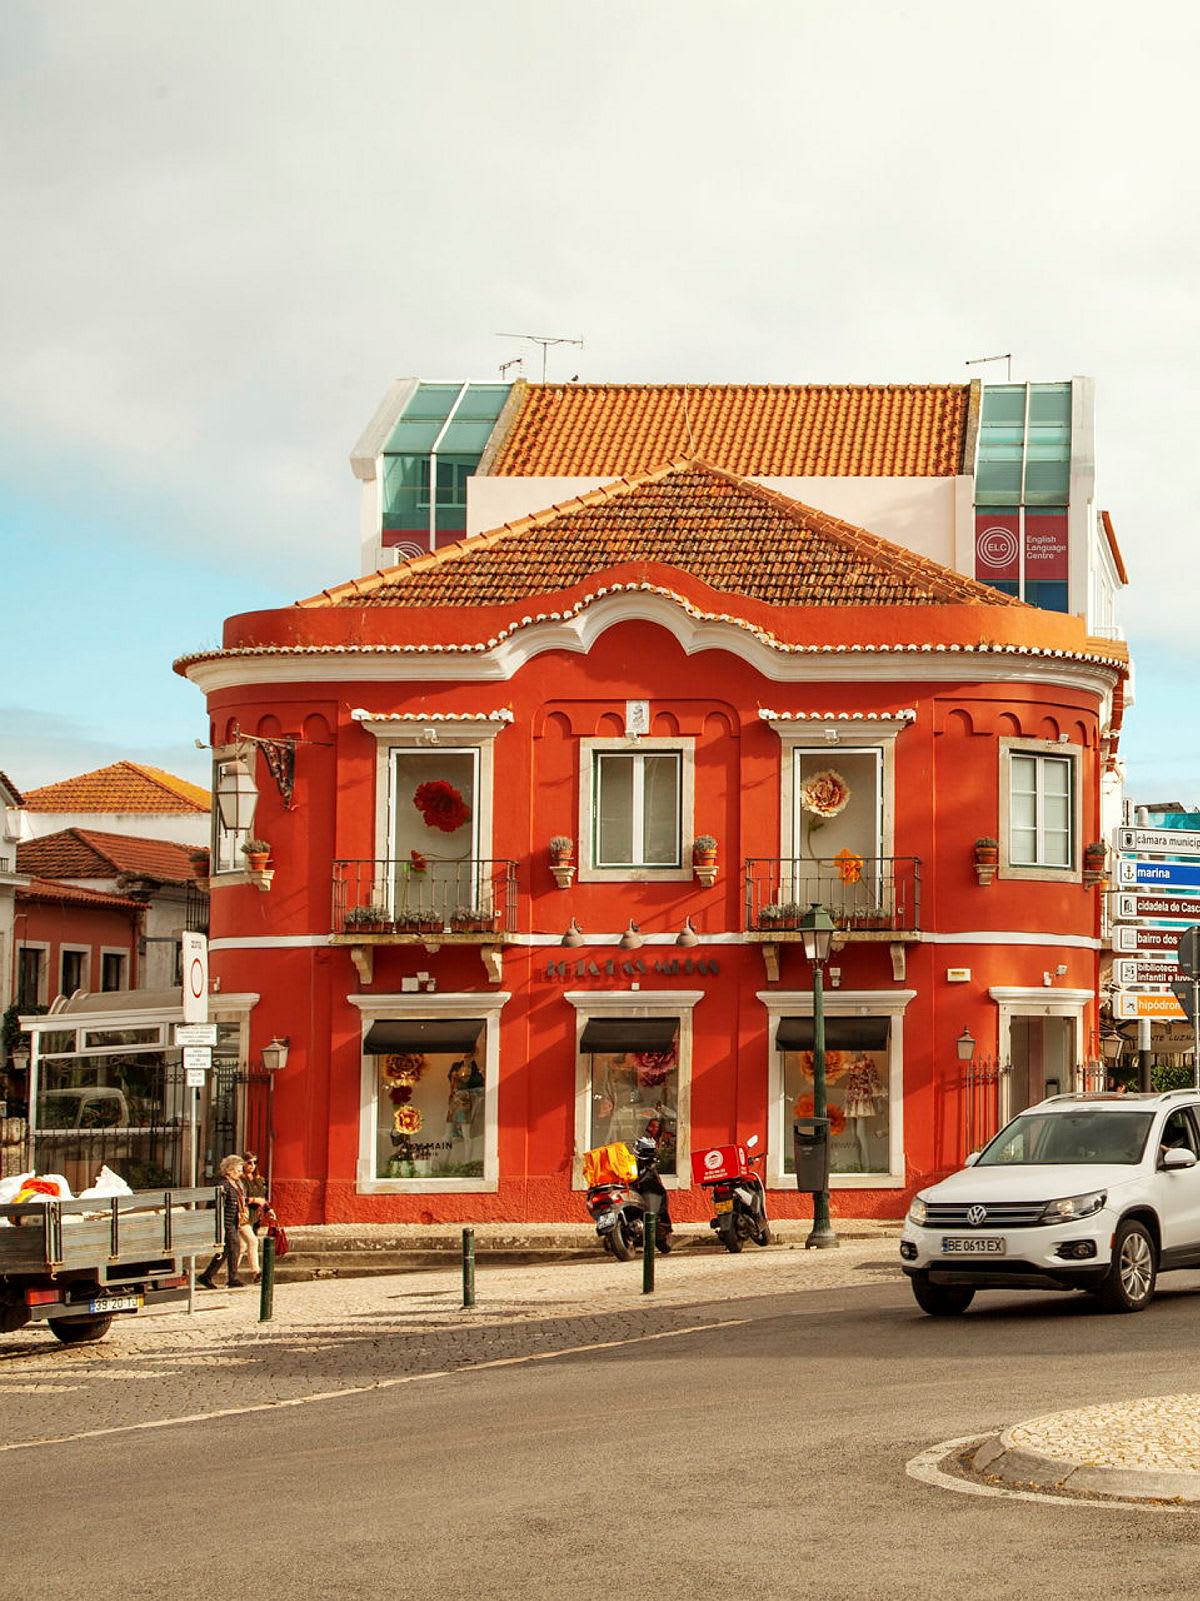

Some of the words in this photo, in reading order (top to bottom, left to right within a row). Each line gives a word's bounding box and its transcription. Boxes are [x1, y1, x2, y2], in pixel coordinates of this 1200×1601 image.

[1026, 535, 1056, 544] English
[987, 543, 1008, 551] ELC
[1026, 544, 1067, 553] Language
[1026, 552, 1054, 560] Centre
[1137, 834, 1168, 846] câmara
[1137, 868, 1171, 878] marina
[1137, 901, 1169, 912] cidadela
[1170, 902, 1180, 912] de
[1137, 933, 1162, 944] bairro
[1163, 934, 1178, 944] dos
[1137, 963, 1178, 972] biblioteca
[1137, 973, 1166, 982] infantil
[948, 1240, 962, 1252] BE
[963, 1240, 986, 1252] 0613
[987, 1240, 1001, 1252] EX
